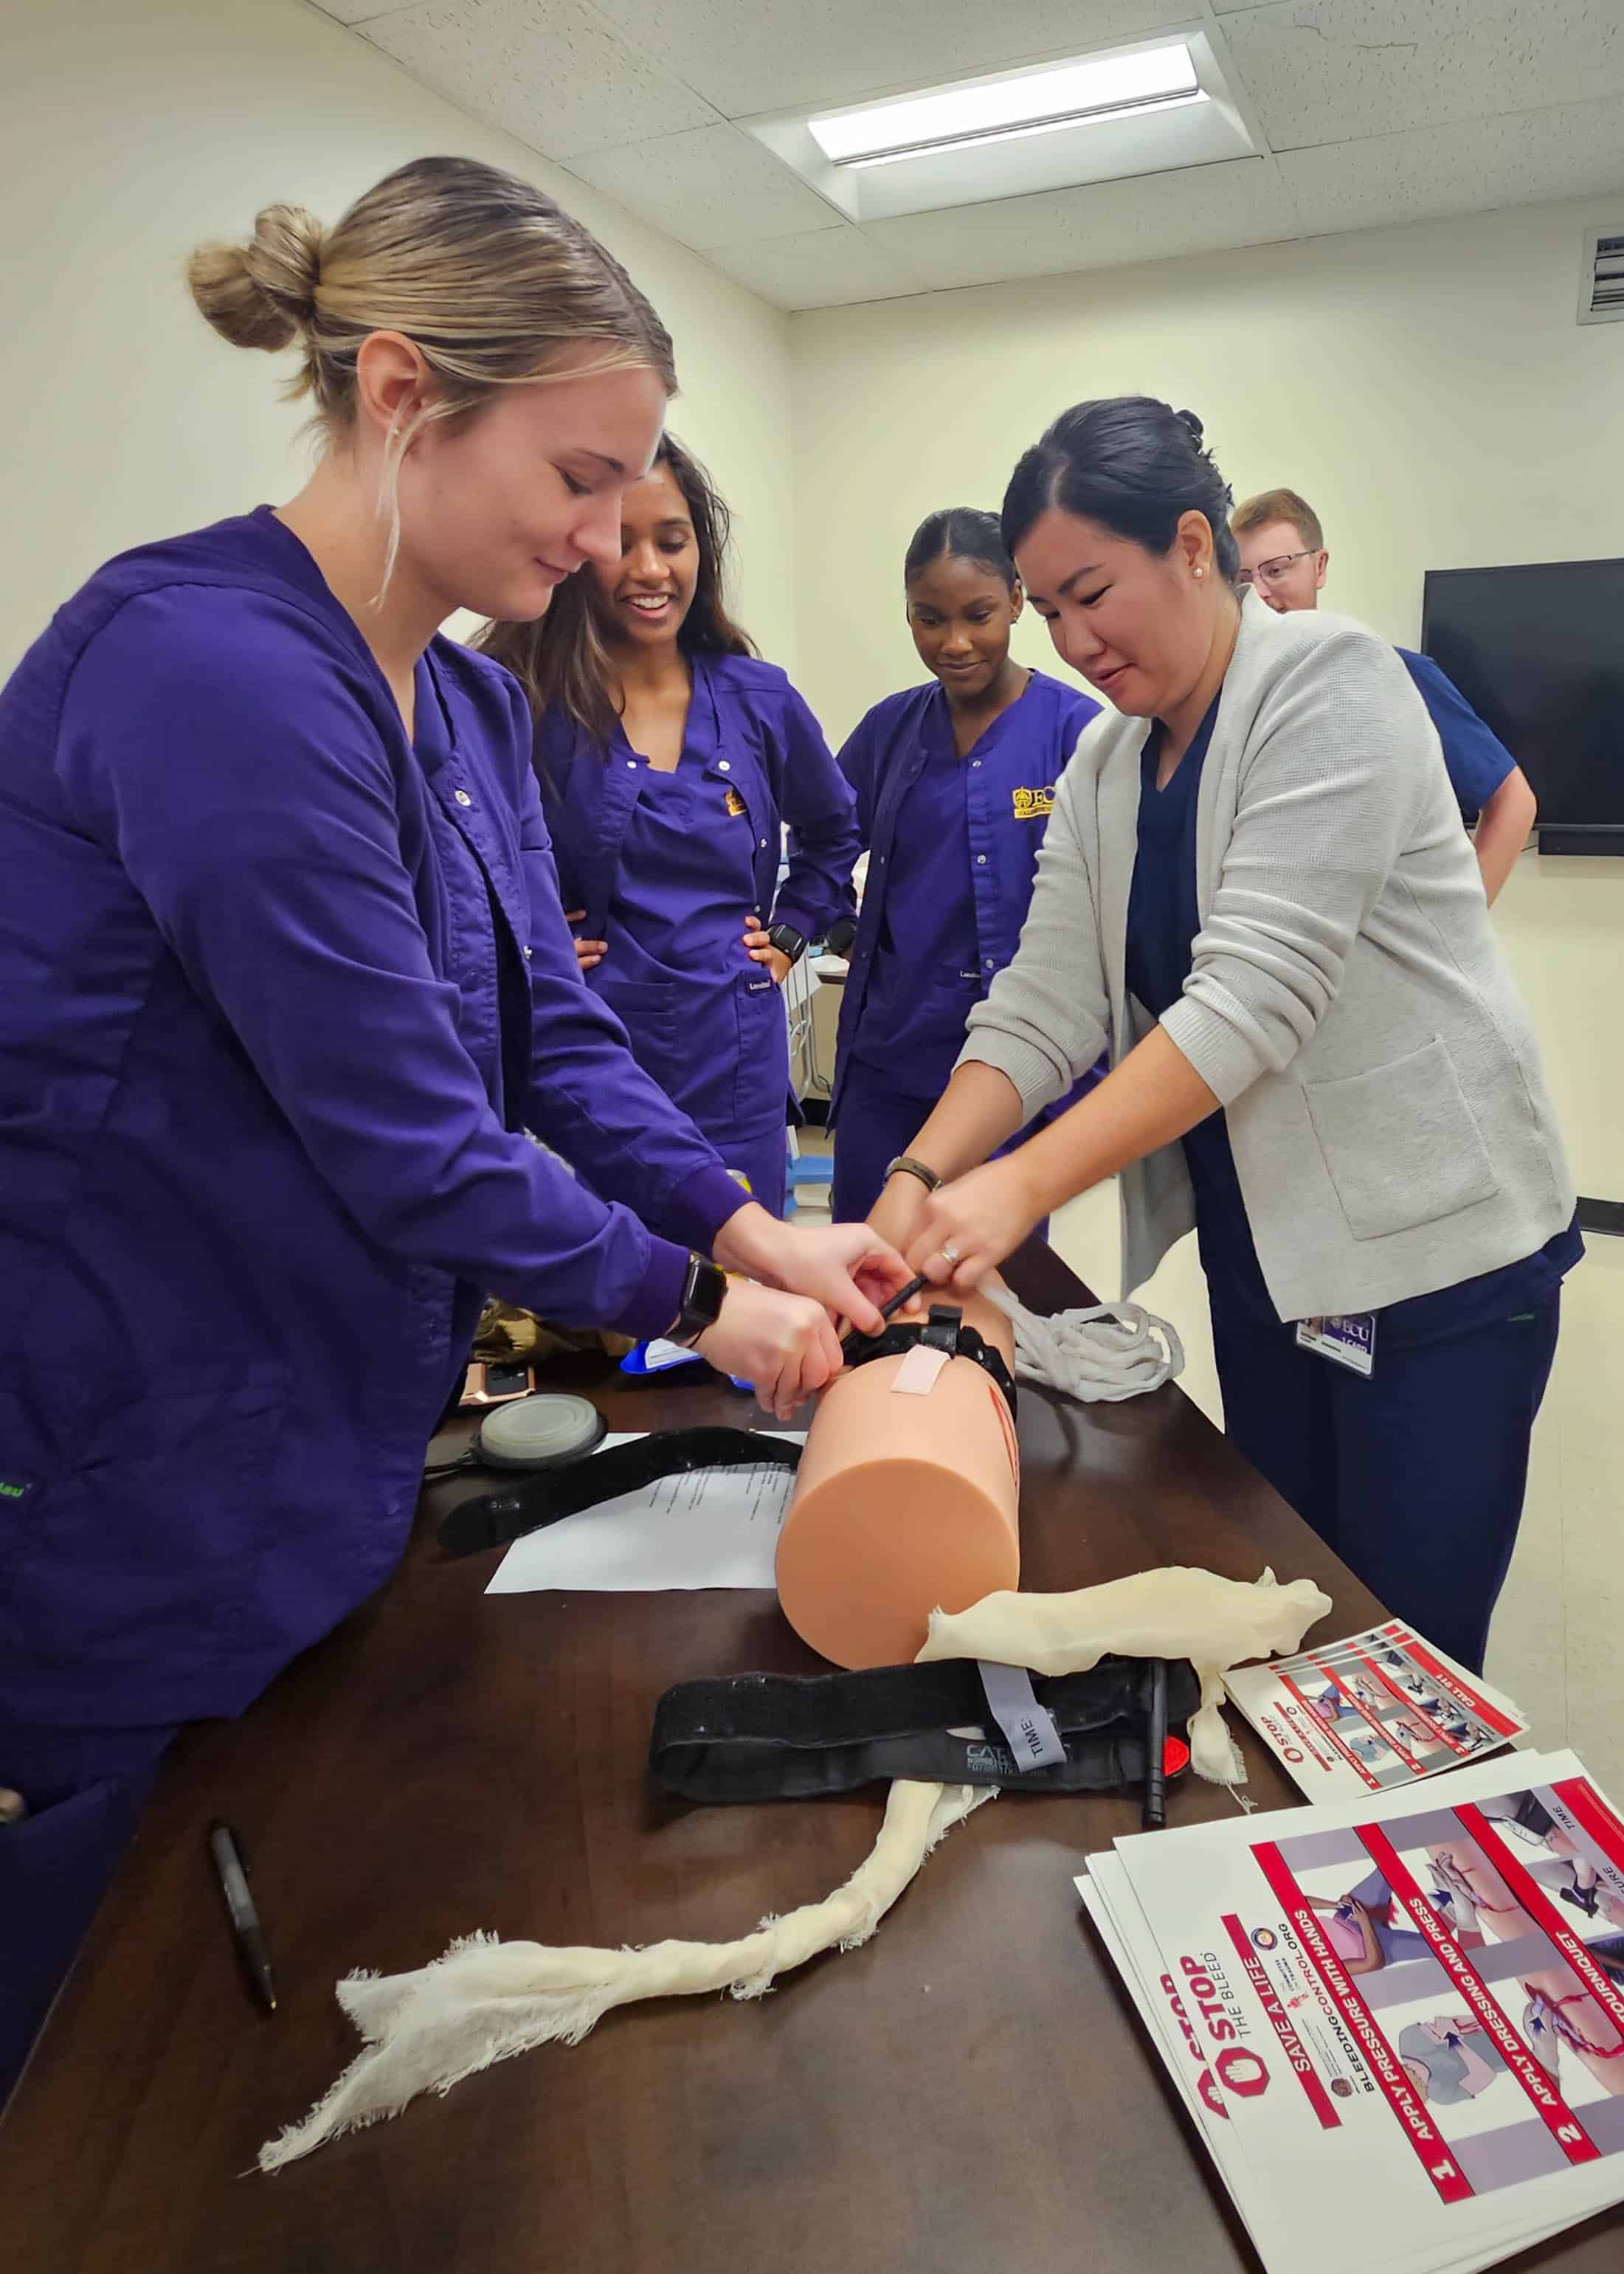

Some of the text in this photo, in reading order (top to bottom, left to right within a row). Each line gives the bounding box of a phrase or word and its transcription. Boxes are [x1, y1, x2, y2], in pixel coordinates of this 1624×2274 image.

[1032, 787, 1056, 806] EC
[1453, 1688, 1476, 1707] CALL
[1261, 1716, 1288, 1746] STOP
[1552, 1805, 1576, 1831] TIME
[1294, 1910, 1330, 1958] HANDS
[1180, 1956, 1236, 2041] STOP
[1321, 1959, 1352, 1997] WITH
[1228, 2006, 1251, 2039] THE
[1245, 1957, 1311, 2072] SAVE A LIFE
[1279, 1924, 1375, 2092] BLEEDINGCONTROL.ORG
[1410, 1898, 1583, 2143] 2 APPLY DRESSING AND PRESS
[1343, 1997, 1400, 2083] PRESSURE
[1395, 2085, 1434, 2140] APPLY
[1431, 2159, 1457, 2180] 1
